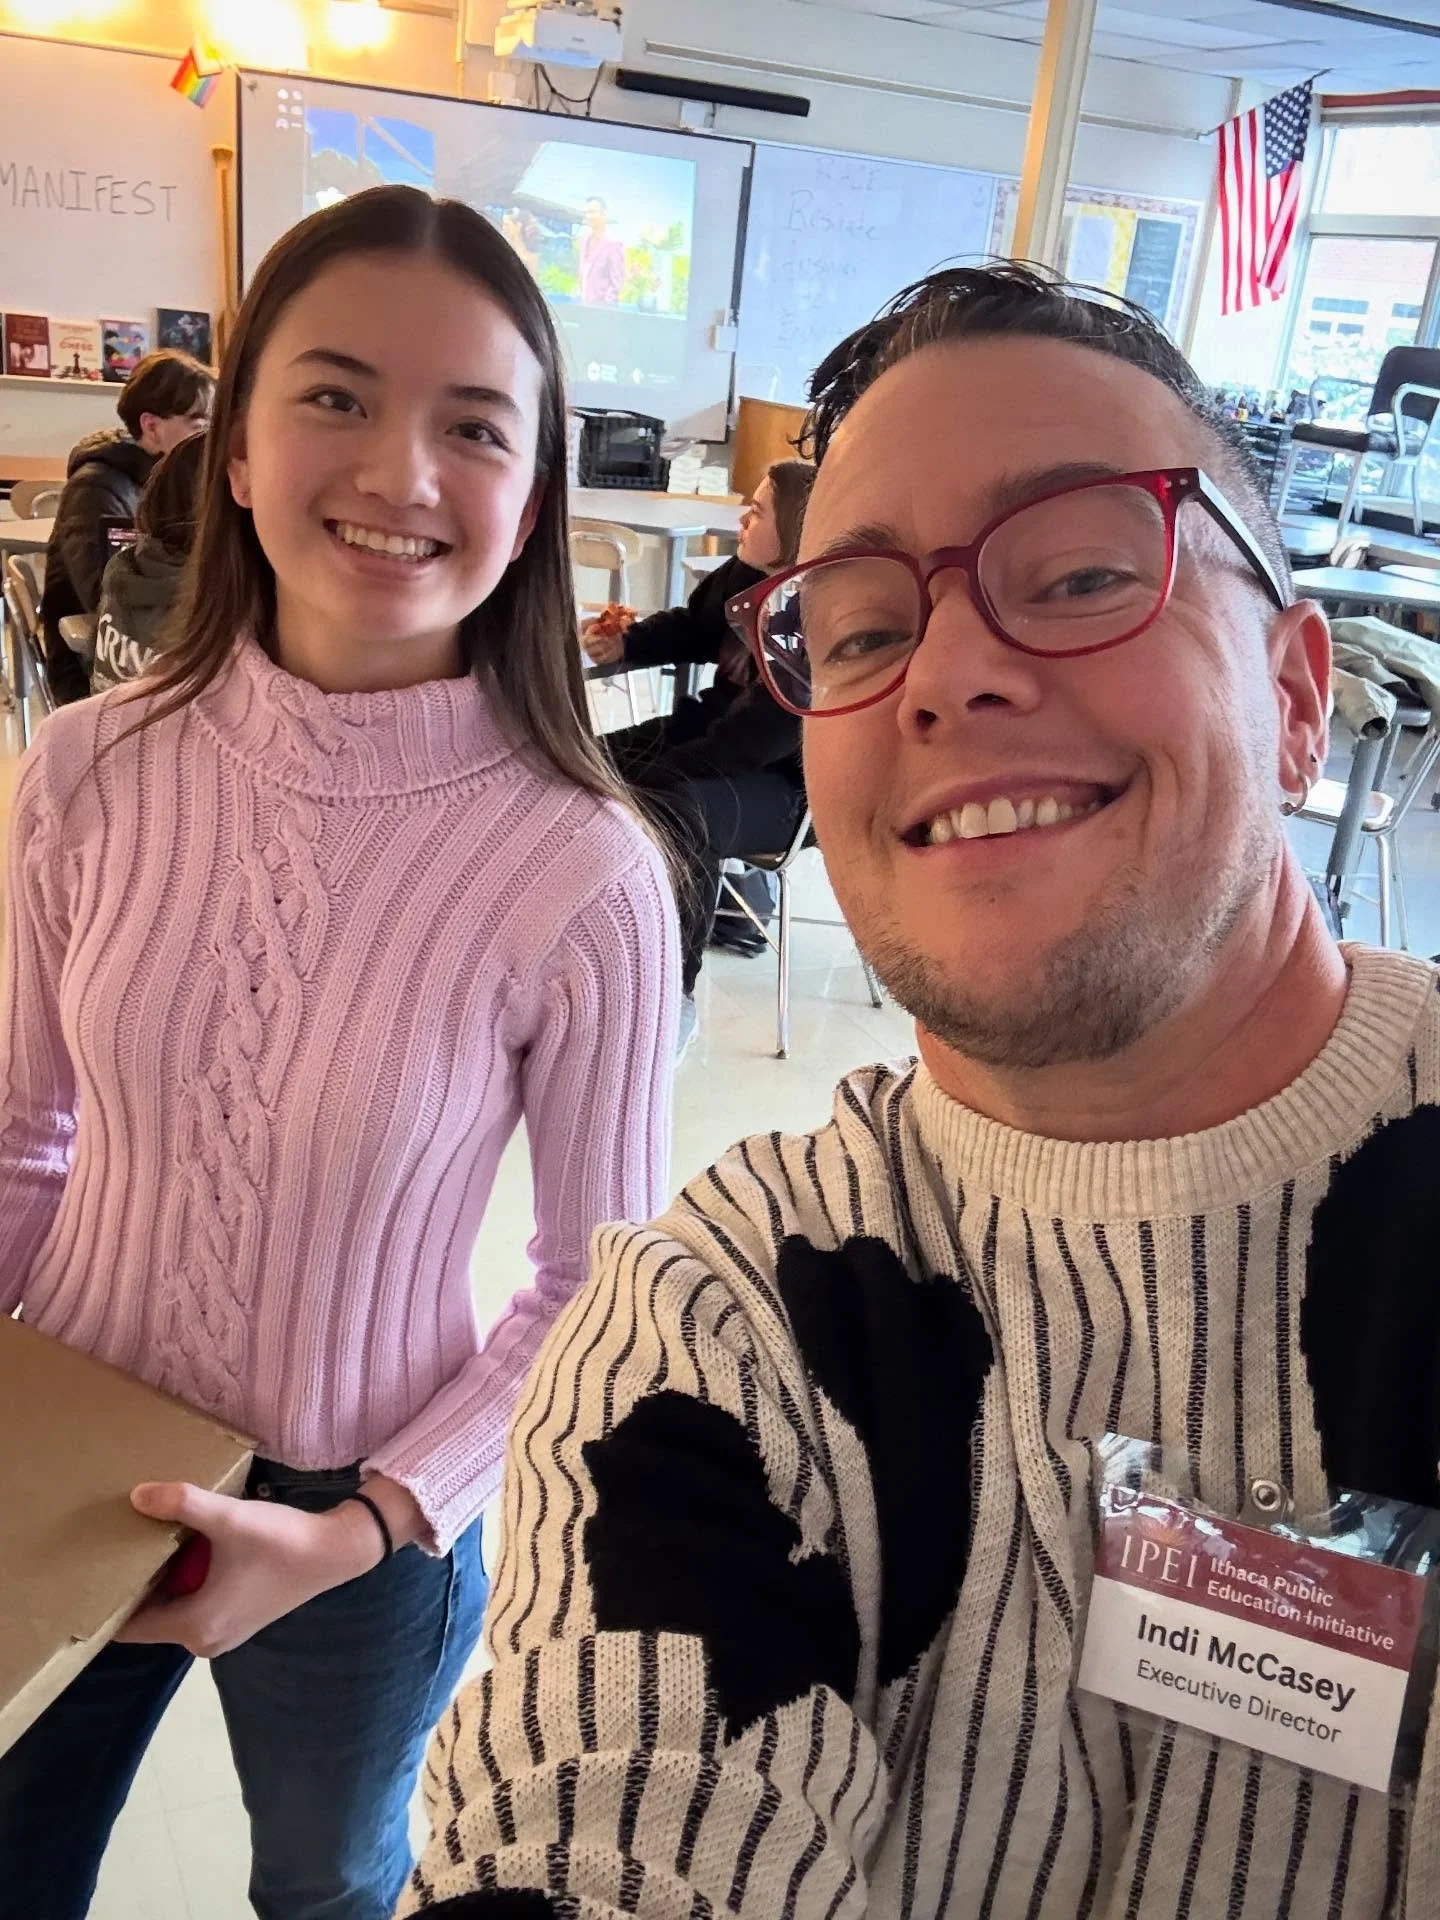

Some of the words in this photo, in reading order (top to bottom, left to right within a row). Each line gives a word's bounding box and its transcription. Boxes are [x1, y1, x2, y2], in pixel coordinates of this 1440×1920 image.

[0, 162, 178, 222] MANIFEST
[1120, 1535, 1198, 1588] IPEI
[1210, 1557, 1268, 1588] Ithaca
[1273, 1576, 1334, 1607] Public
[1207, 1580, 1301, 1621] Education
[1306, 1610, 1394, 1650] Initiative
[1138, 1614, 1199, 1656] Indi
[1207, 1635, 1356, 1712] McCasey
[1137, 1658, 1241, 1710] Executive
[1248, 1695, 1342, 1743] Director
